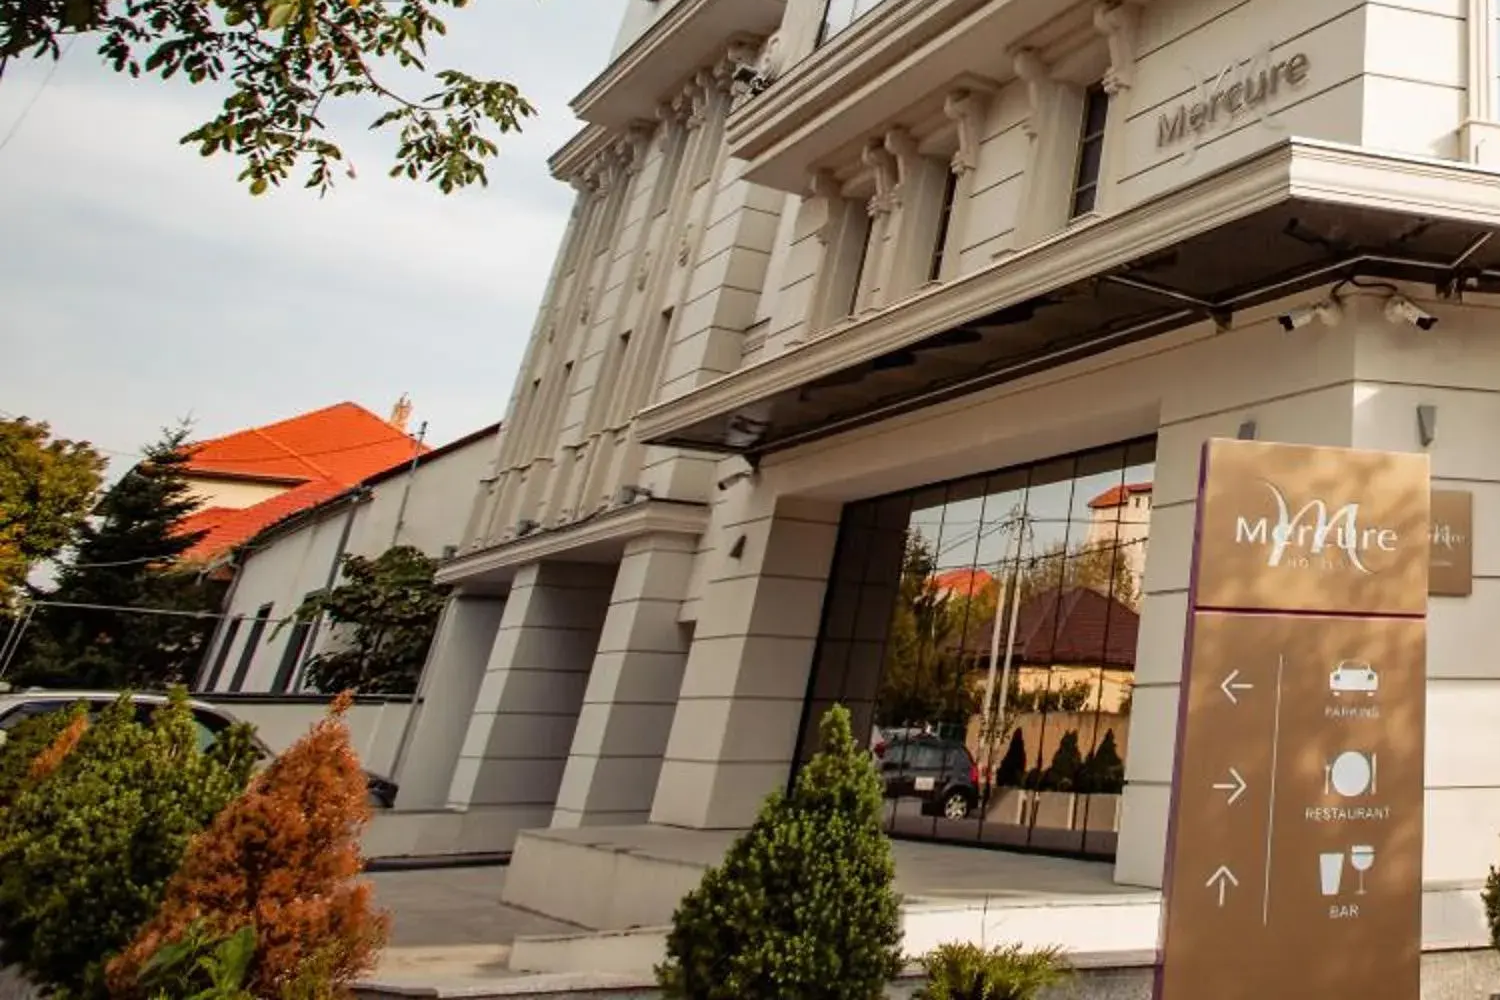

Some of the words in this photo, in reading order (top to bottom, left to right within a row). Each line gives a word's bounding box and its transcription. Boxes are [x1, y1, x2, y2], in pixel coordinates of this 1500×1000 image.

[1156, 52, 1309, 148] Mercure
[1324, 704, 1380, 719] PARKING
[1304, 804, 1391, 821] RESTAURANT
[1329, 904, 1360, 919] BAR
